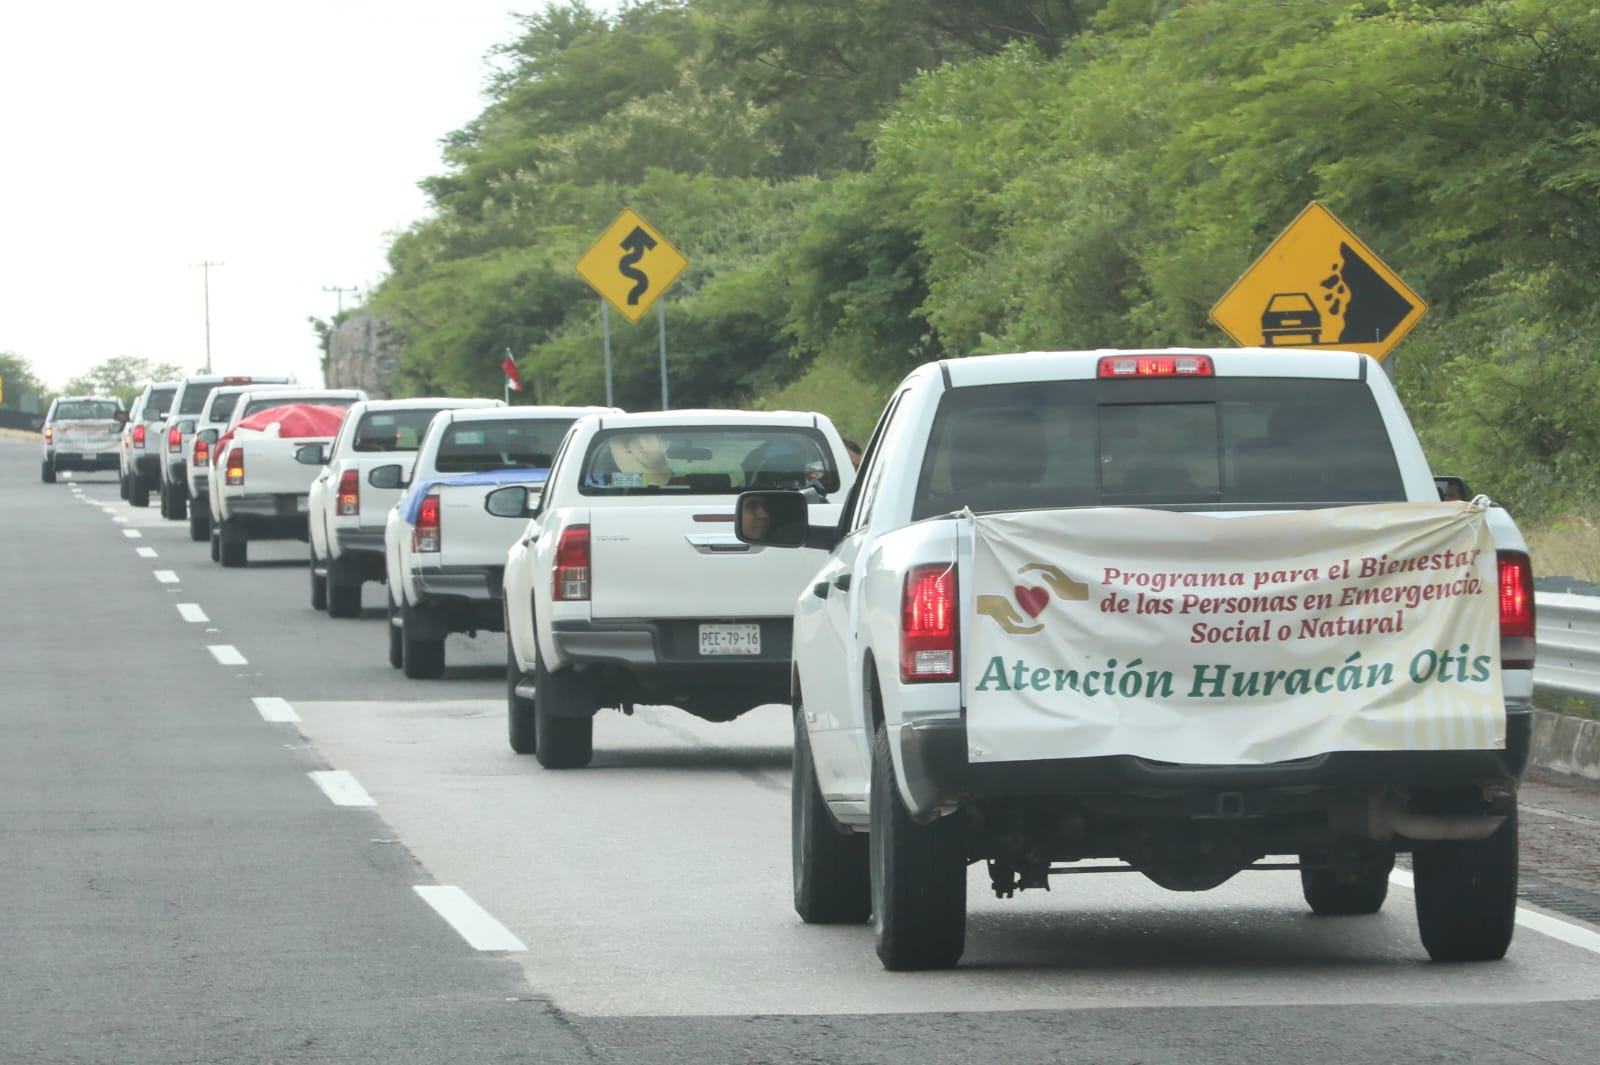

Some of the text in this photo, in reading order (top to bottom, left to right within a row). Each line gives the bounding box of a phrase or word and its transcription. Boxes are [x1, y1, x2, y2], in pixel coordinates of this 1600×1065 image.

[1101, 548, 1481, 592] Programa para el Bienestar
[1100, 591, 1129, 613] de
[1136, 591, 1174, 614] las
[1180, 593, 1298, 614] Personas
[1303, 592, 1333, 610] en
[702, 631, 759, 646] PEE-79-16
[1190, 609, 1404, 643] Social o Natural
[975, 643, 1492, 698] Atención Huracán Otis
